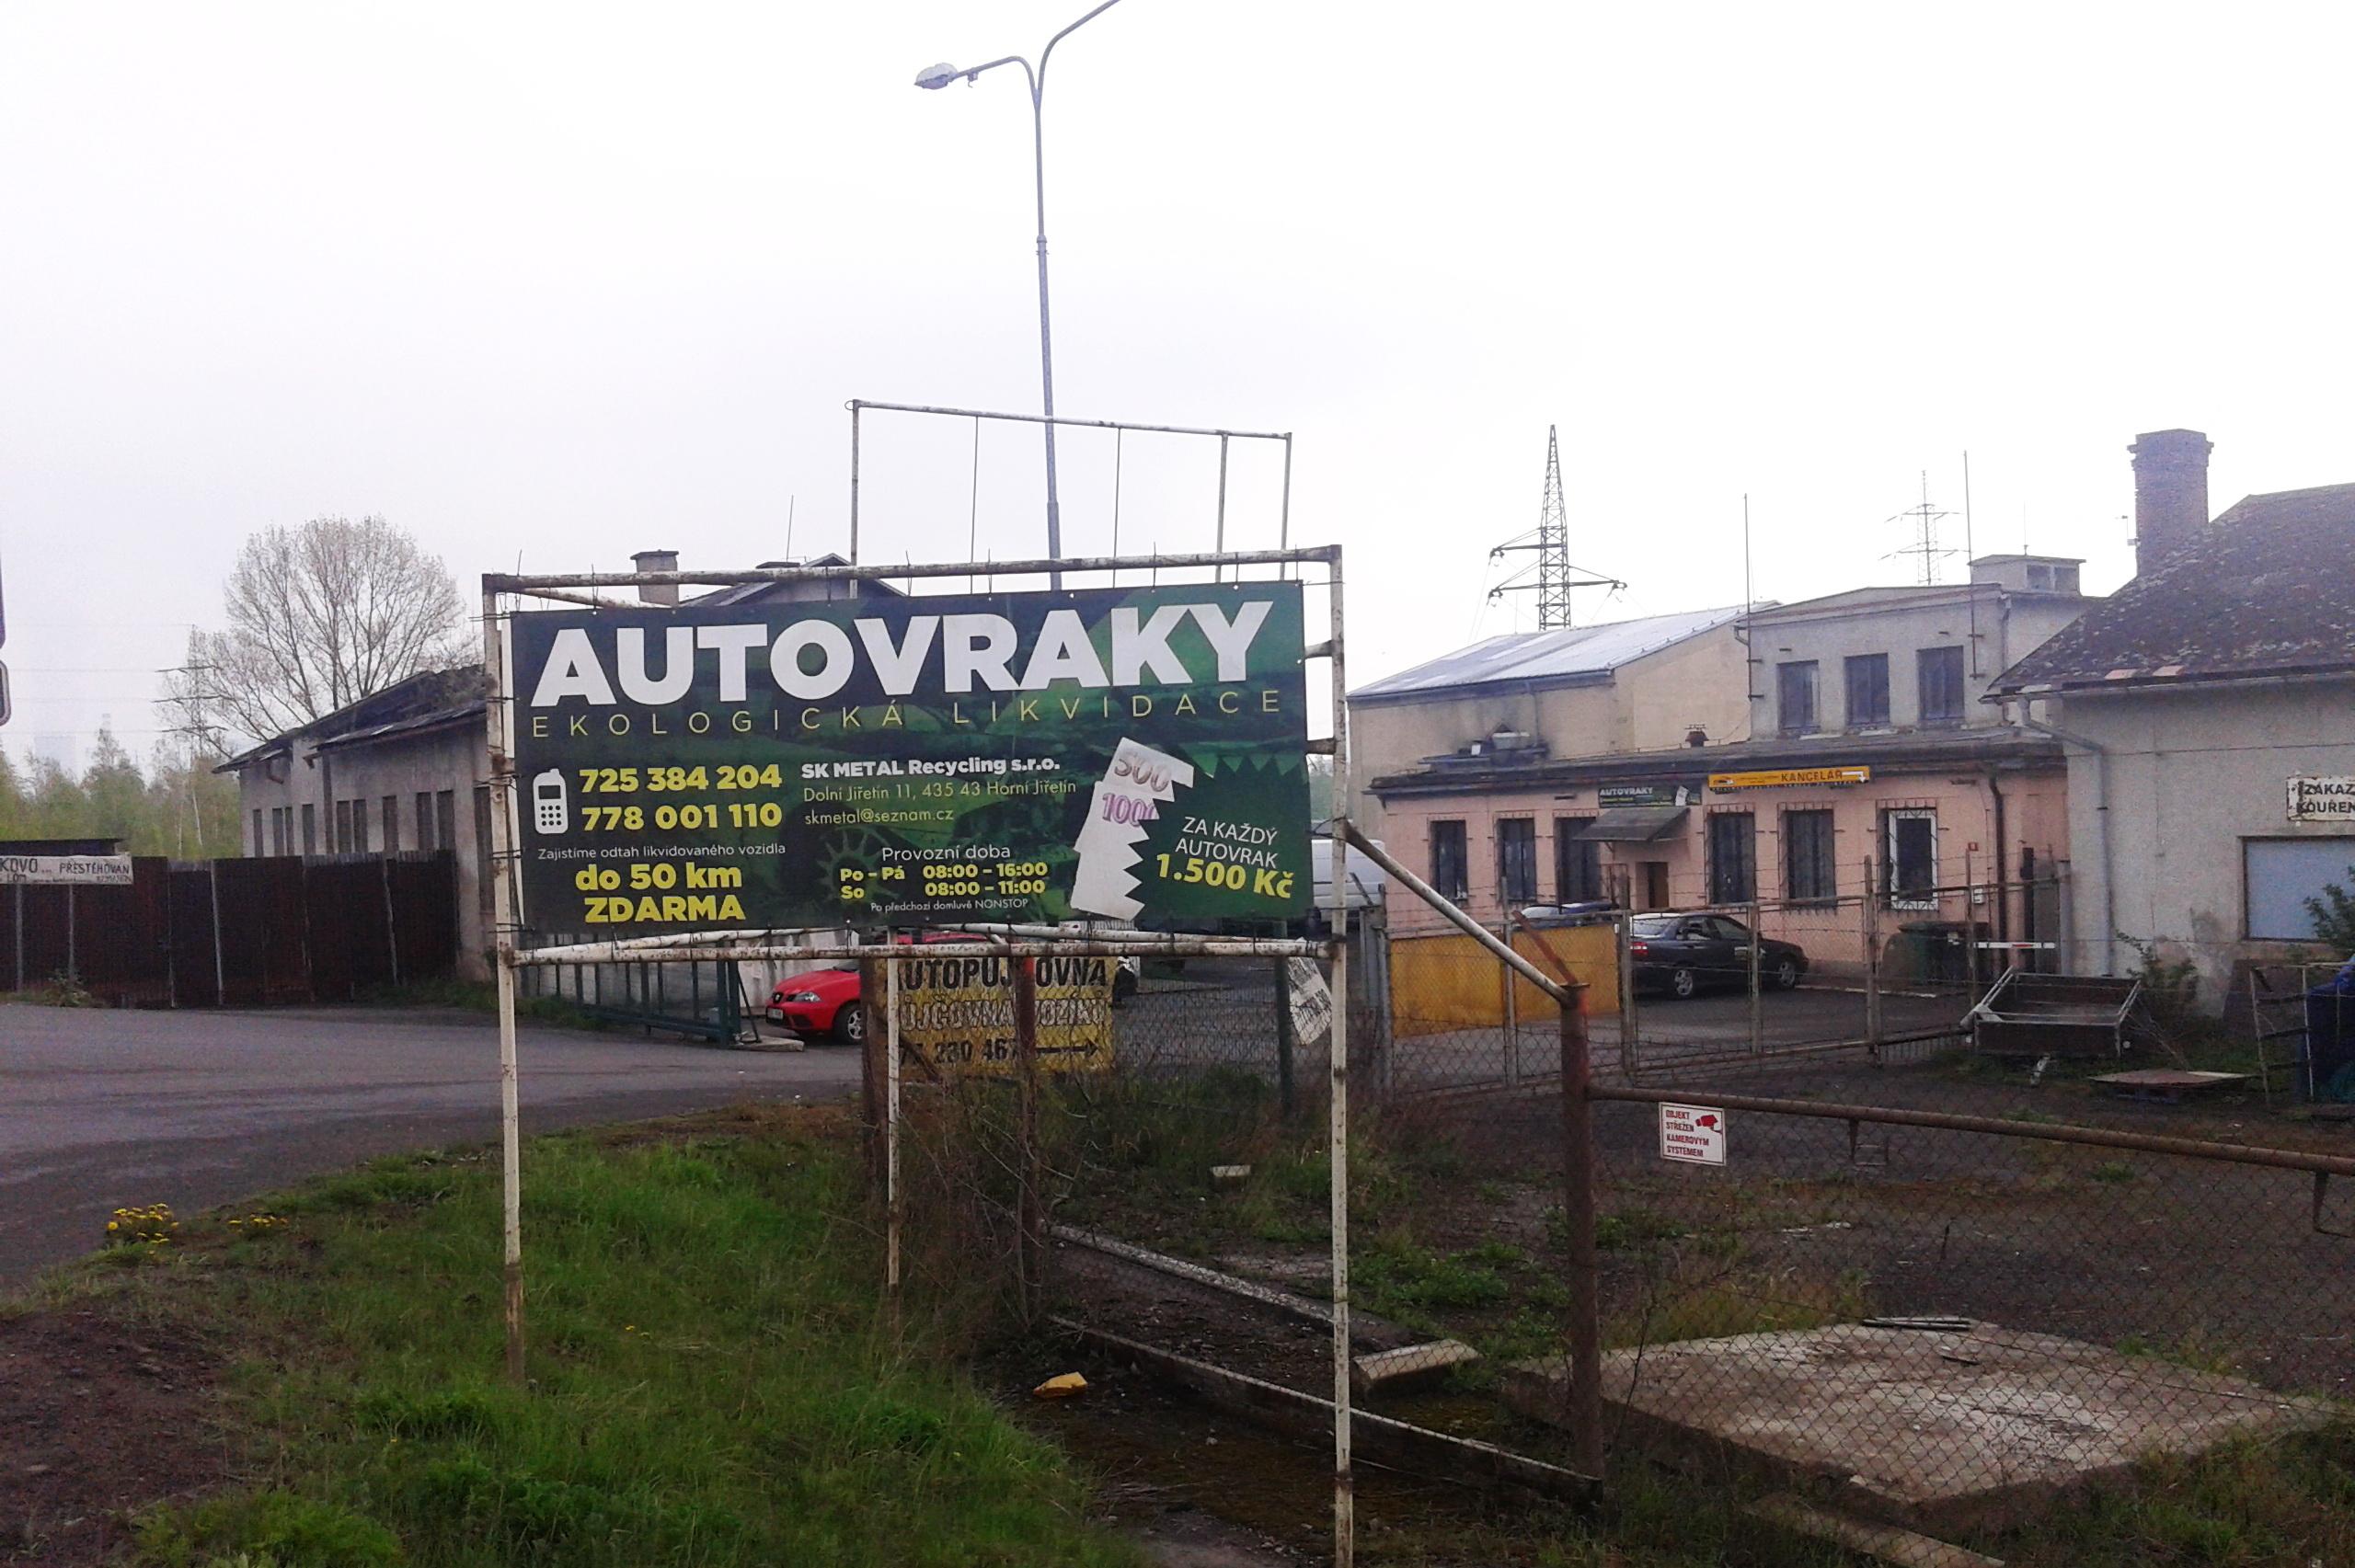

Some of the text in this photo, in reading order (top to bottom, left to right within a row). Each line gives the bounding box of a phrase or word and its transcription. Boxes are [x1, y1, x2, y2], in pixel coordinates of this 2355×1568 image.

[530, 600, 1274, 707] AUTOVRAKY
[534, 690, 1280, 738] EKOLOGICKÁ LIKVIDACE
[580, 764, 782, 793] 725 384 204
[801, 758, 1061, 779] SK METAL Recycling s.r.o.
[1114, 751, 1172, 792] 500
[803, 779, 1076, 802] Dolní Jiřetín 11, 435 43 Horní Jiřetín
[581, 802, 782, 831] 778 001 110
[805, 809, 954, 825] skmetal@seznam.cz
[1182, 817, 1278, 846] ZA KAŽDÝ
[538, 842, 787, 862] Zajistíme odtah likvidovaného vozidla
[882, 843, 1010, 862] Provozní doba
[1175, 838, 1278, 869] AUTOVRAK
[575, 862, 742, 890] do 50 km
[840, 867, 864, 882] Po
[881, 864, 905, 880] Pá
[923, 864, 978, 879] 08:00
[995, 862, 1048, 877] 16:00
[1156, 853, 1295, 898] 1.500 Kč
[841, 885, 865, 899] So
[925, 881, 980, 897] 08:00
[998, 879, 1046, 895] 11:00
[584, 894, 746, 923] ZDARMA
[870, 902, 882, 911] Po
[975, 898, 1028, 910] NONSTOP
[885, 956, 1107, 990] UTOPUJOVNA
